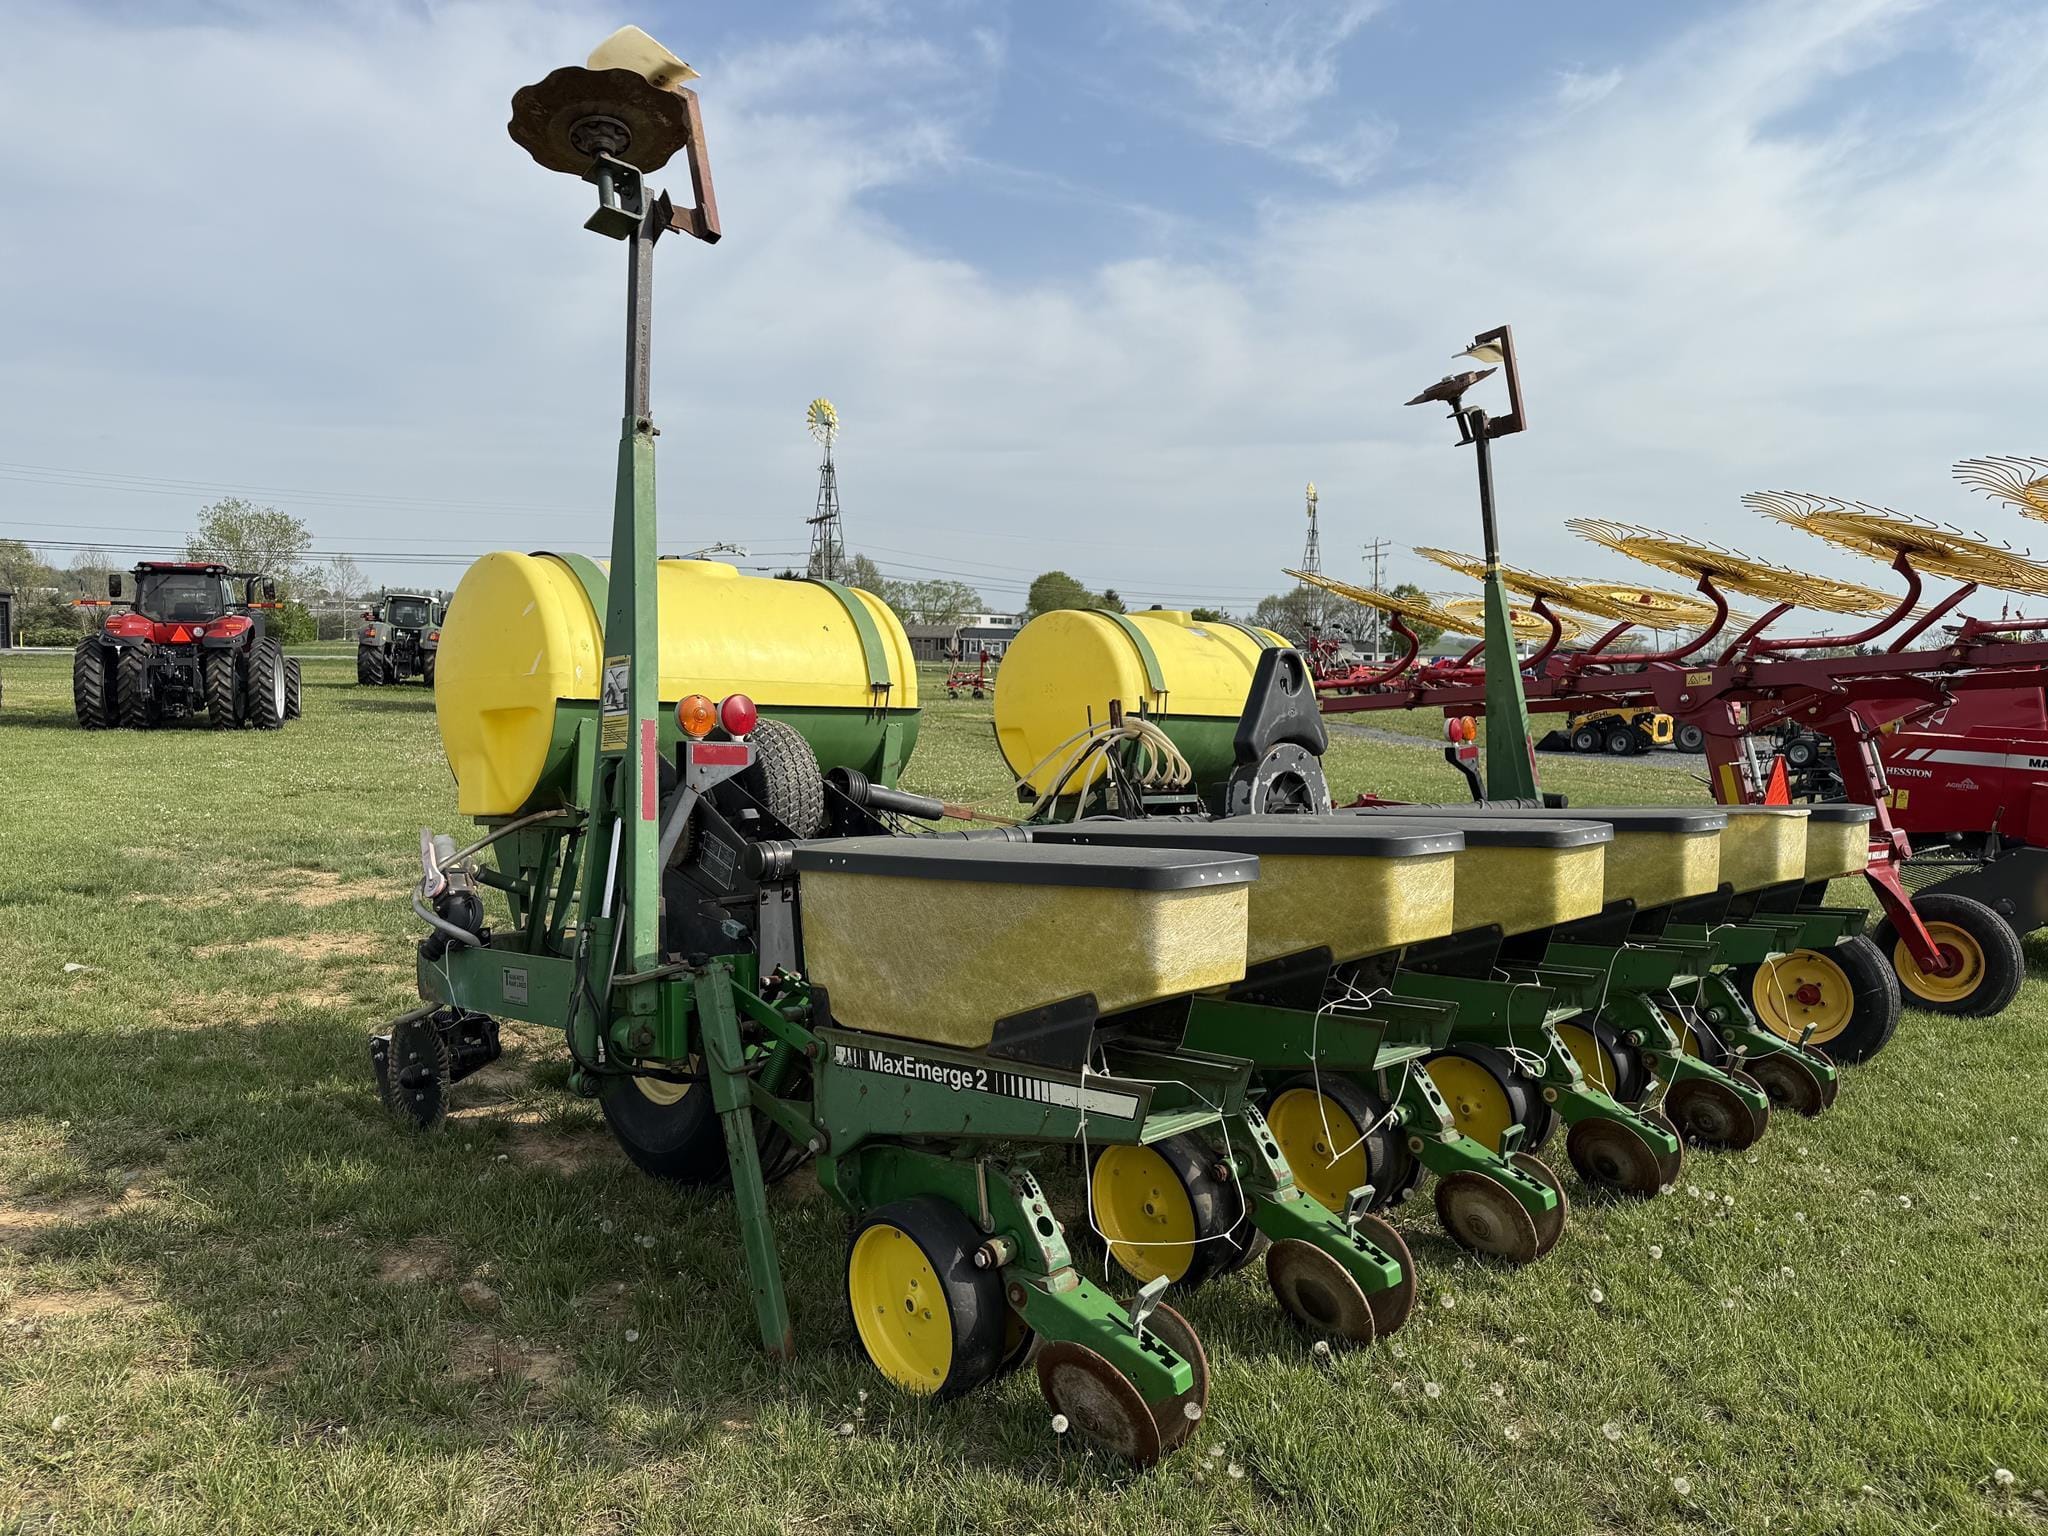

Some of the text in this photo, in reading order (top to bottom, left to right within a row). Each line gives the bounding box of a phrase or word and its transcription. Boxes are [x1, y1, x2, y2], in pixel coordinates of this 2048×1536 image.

[1587, 711, 1612, 721] GEHL
[1886, 766, 1933, 779] HESSTON
[868, 1050, 989, 1092] MaxEmerge 2
